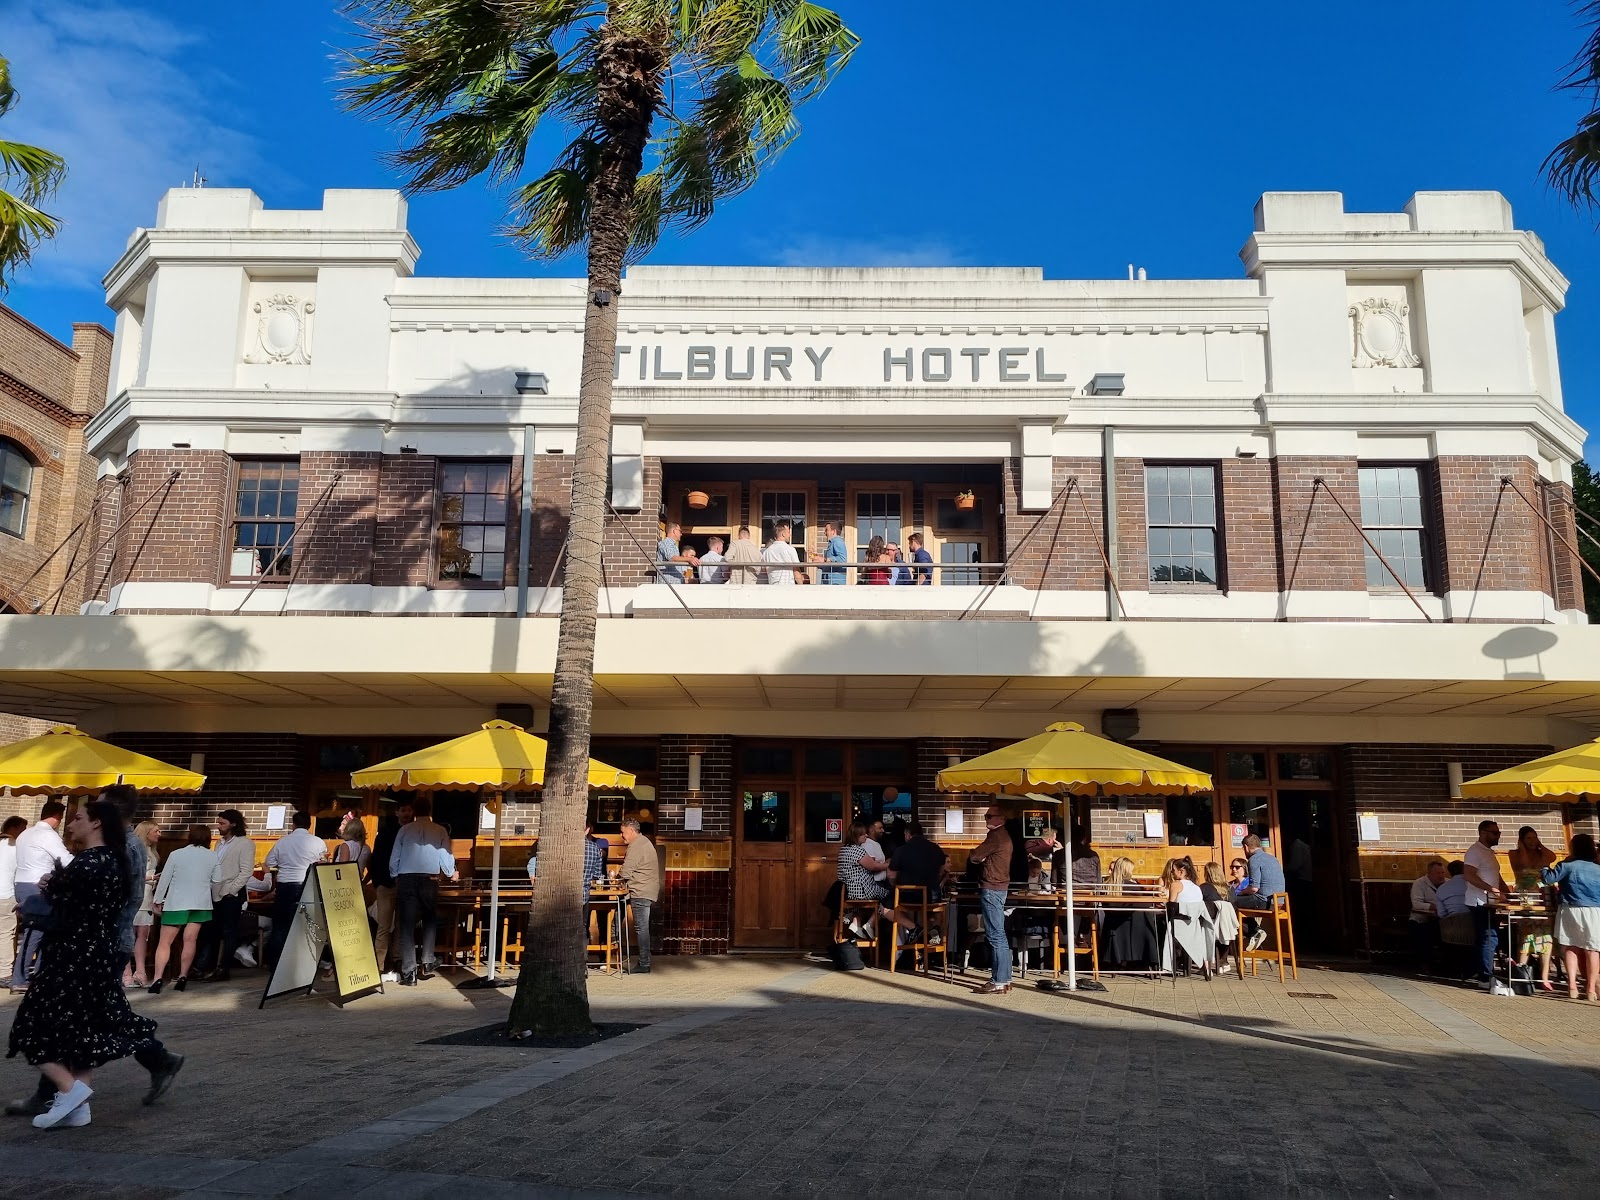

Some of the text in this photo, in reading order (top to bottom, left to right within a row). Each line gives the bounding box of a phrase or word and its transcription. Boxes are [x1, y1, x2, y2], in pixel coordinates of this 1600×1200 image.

[613, 346, 1067, 382] TILBURY HOTEL
[329, 887, 355, 899] FUNCTION
[337, 919, 348, 928] BOOK
[347, 927, 360, 936] SPECIAL
[348, 974, 370, 986] Tilbury
